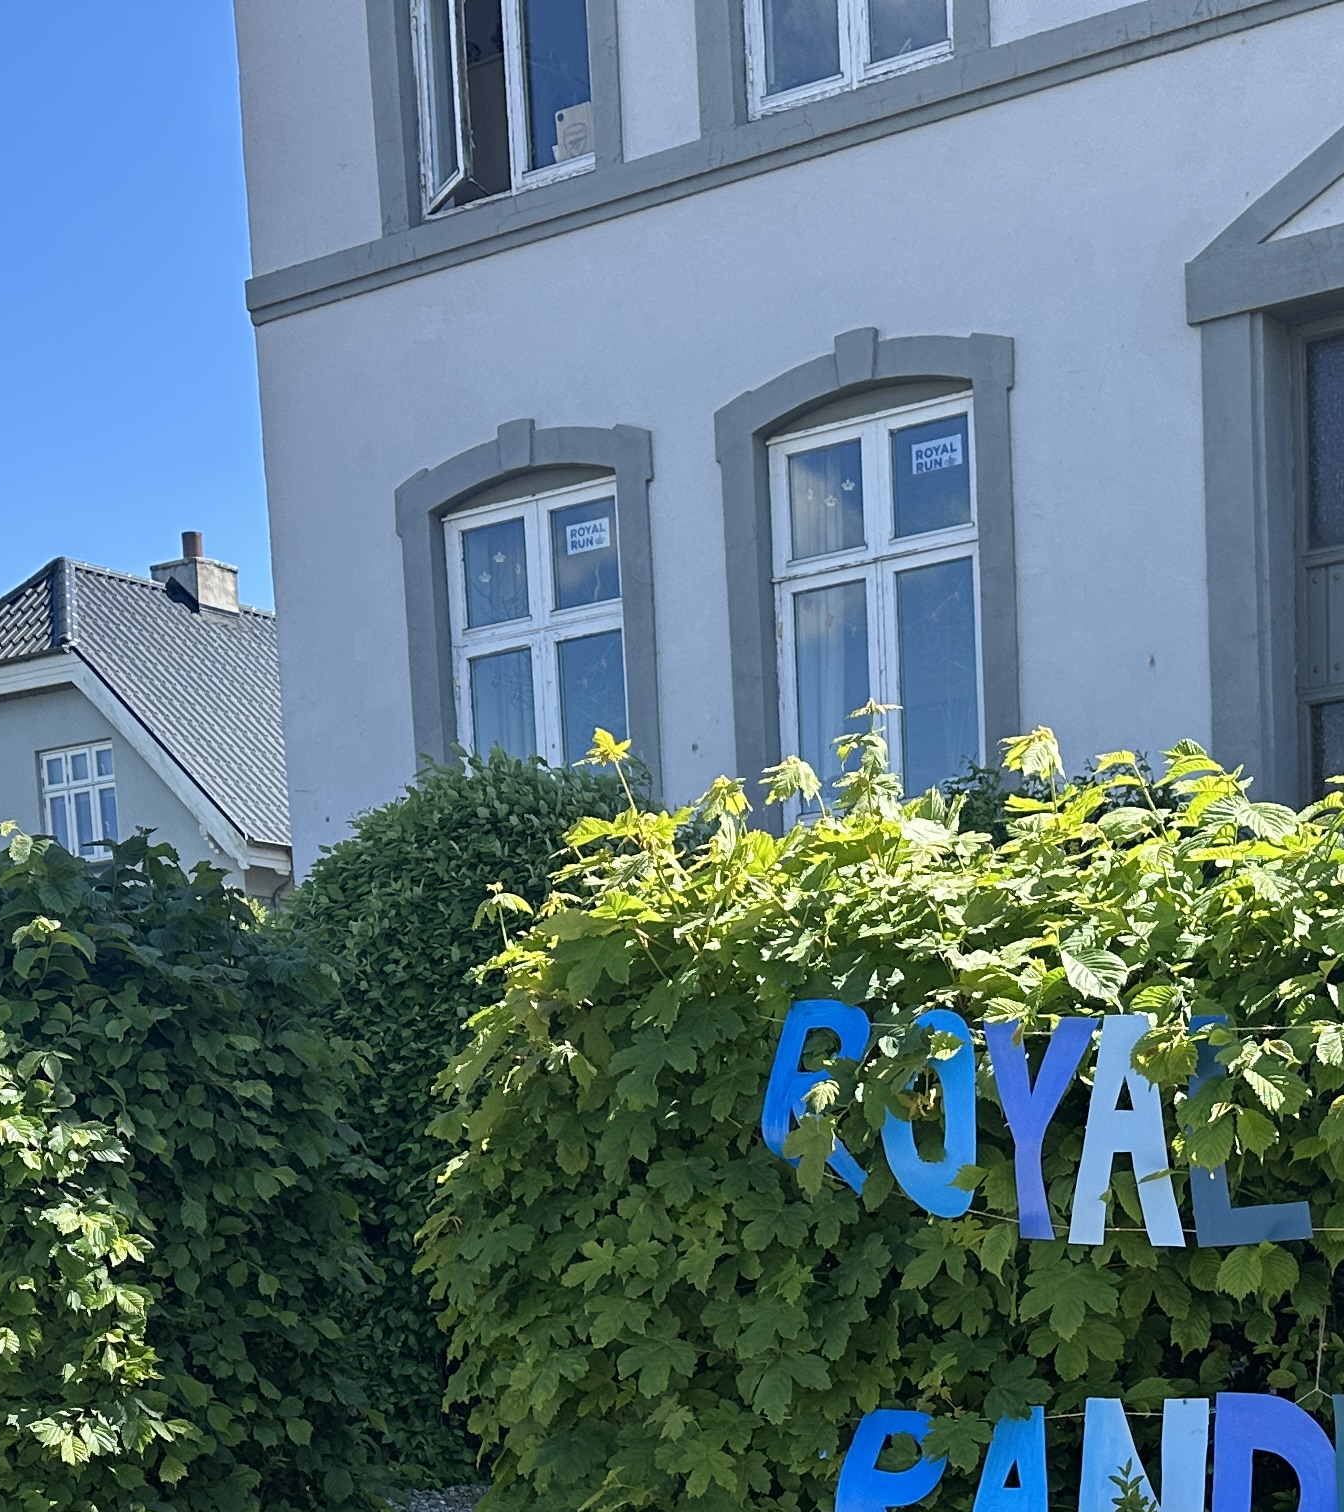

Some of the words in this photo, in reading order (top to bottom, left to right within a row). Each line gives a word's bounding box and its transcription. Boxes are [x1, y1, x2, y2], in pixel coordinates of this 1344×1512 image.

[916, 442, 957, 461] ROYAL
[916, 457, 942, 473] RUN
[570, 523, 606, 539] ROYAL
[570, 535, 594, 551] RUN
[761, 1000, 1313, 1248] ROYAL
